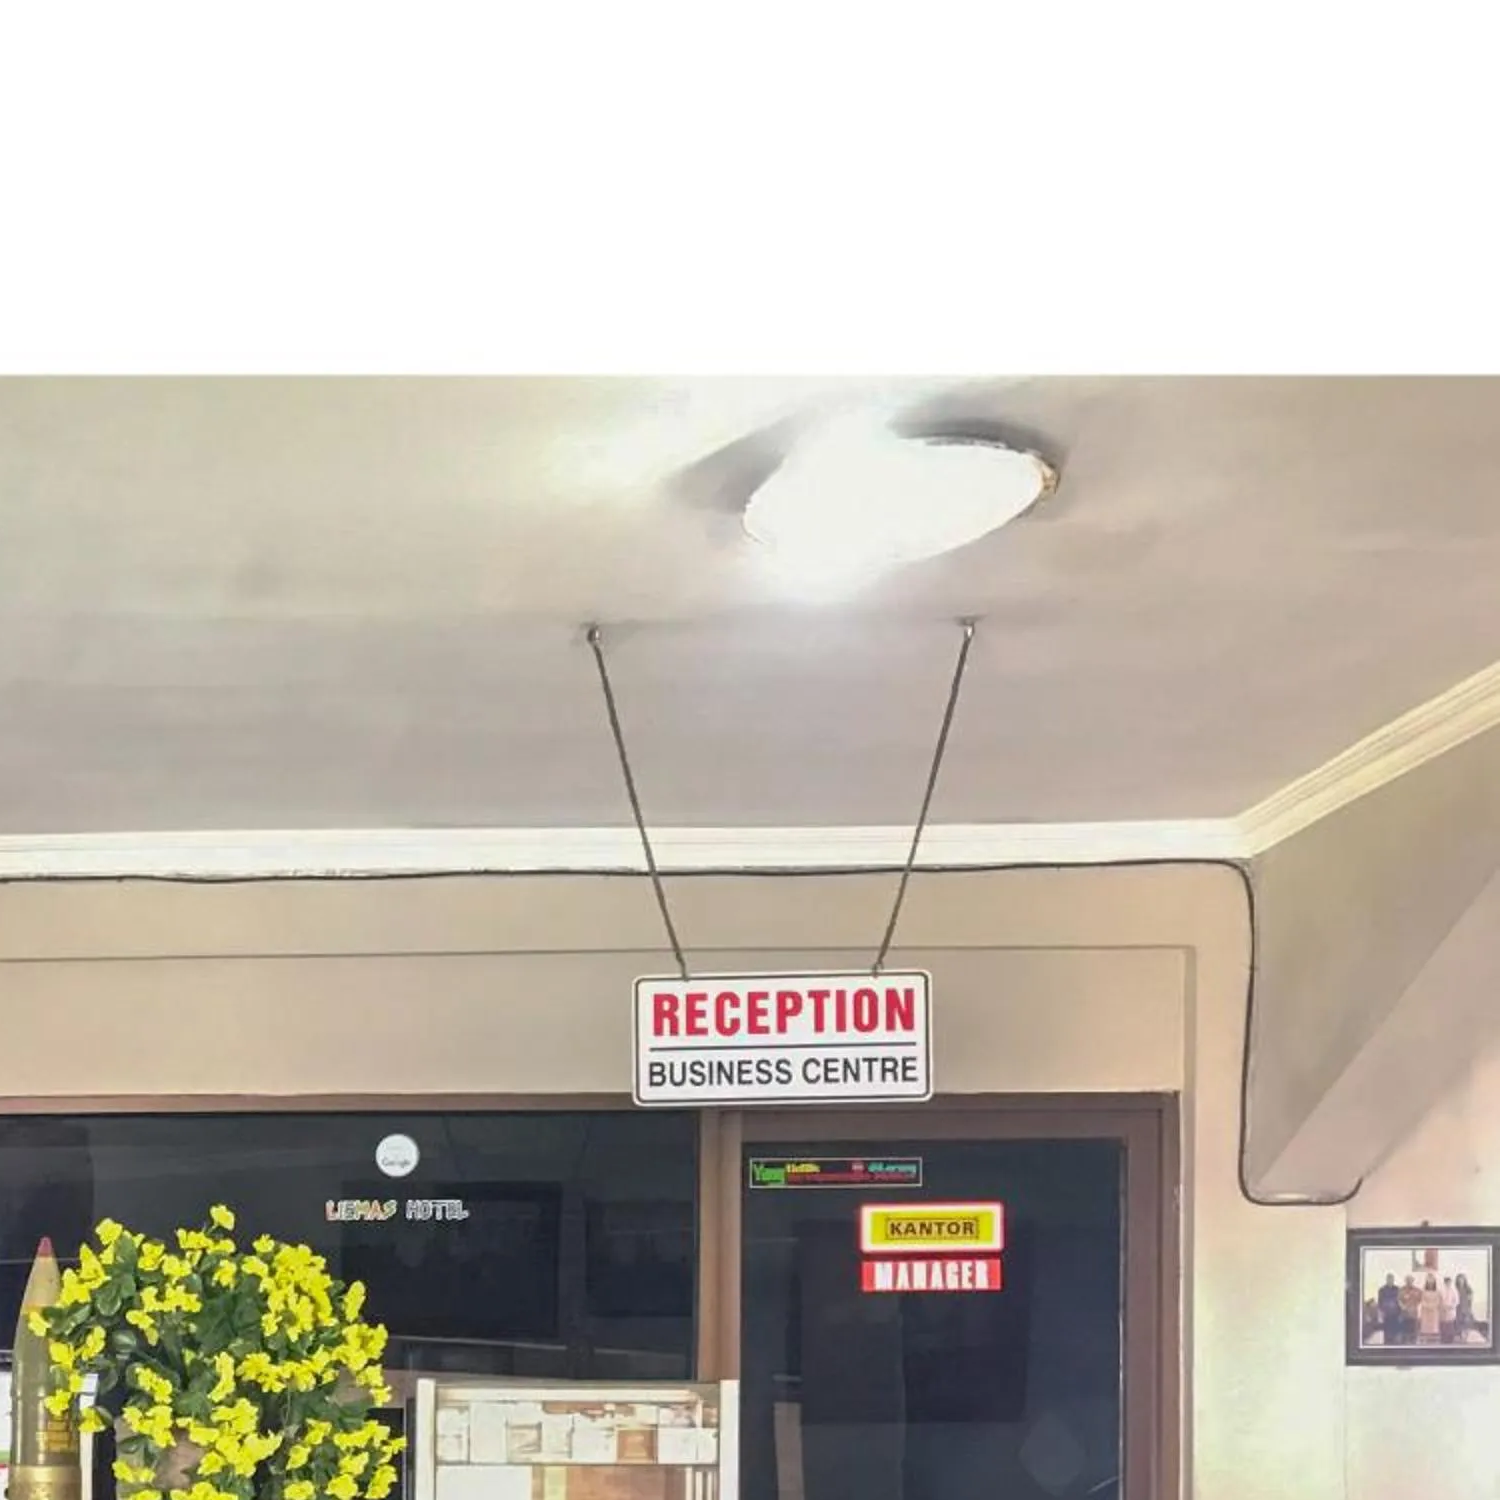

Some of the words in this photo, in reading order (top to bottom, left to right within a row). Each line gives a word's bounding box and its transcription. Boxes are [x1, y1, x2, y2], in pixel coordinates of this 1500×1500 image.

[652, 988, 915, 1037] RECEPTION
[648, 1058, 793, 1087] BUSINESS
[801, 1056, 919, 1084] CENTRE
[325, 1199, 397, 1221] LIEMAS
[405, 1199, 470, 1221] HOTEL
[888, 1219, 976, 1238] KANTOR
[874, 1260, 989, 1291] MANAGER
